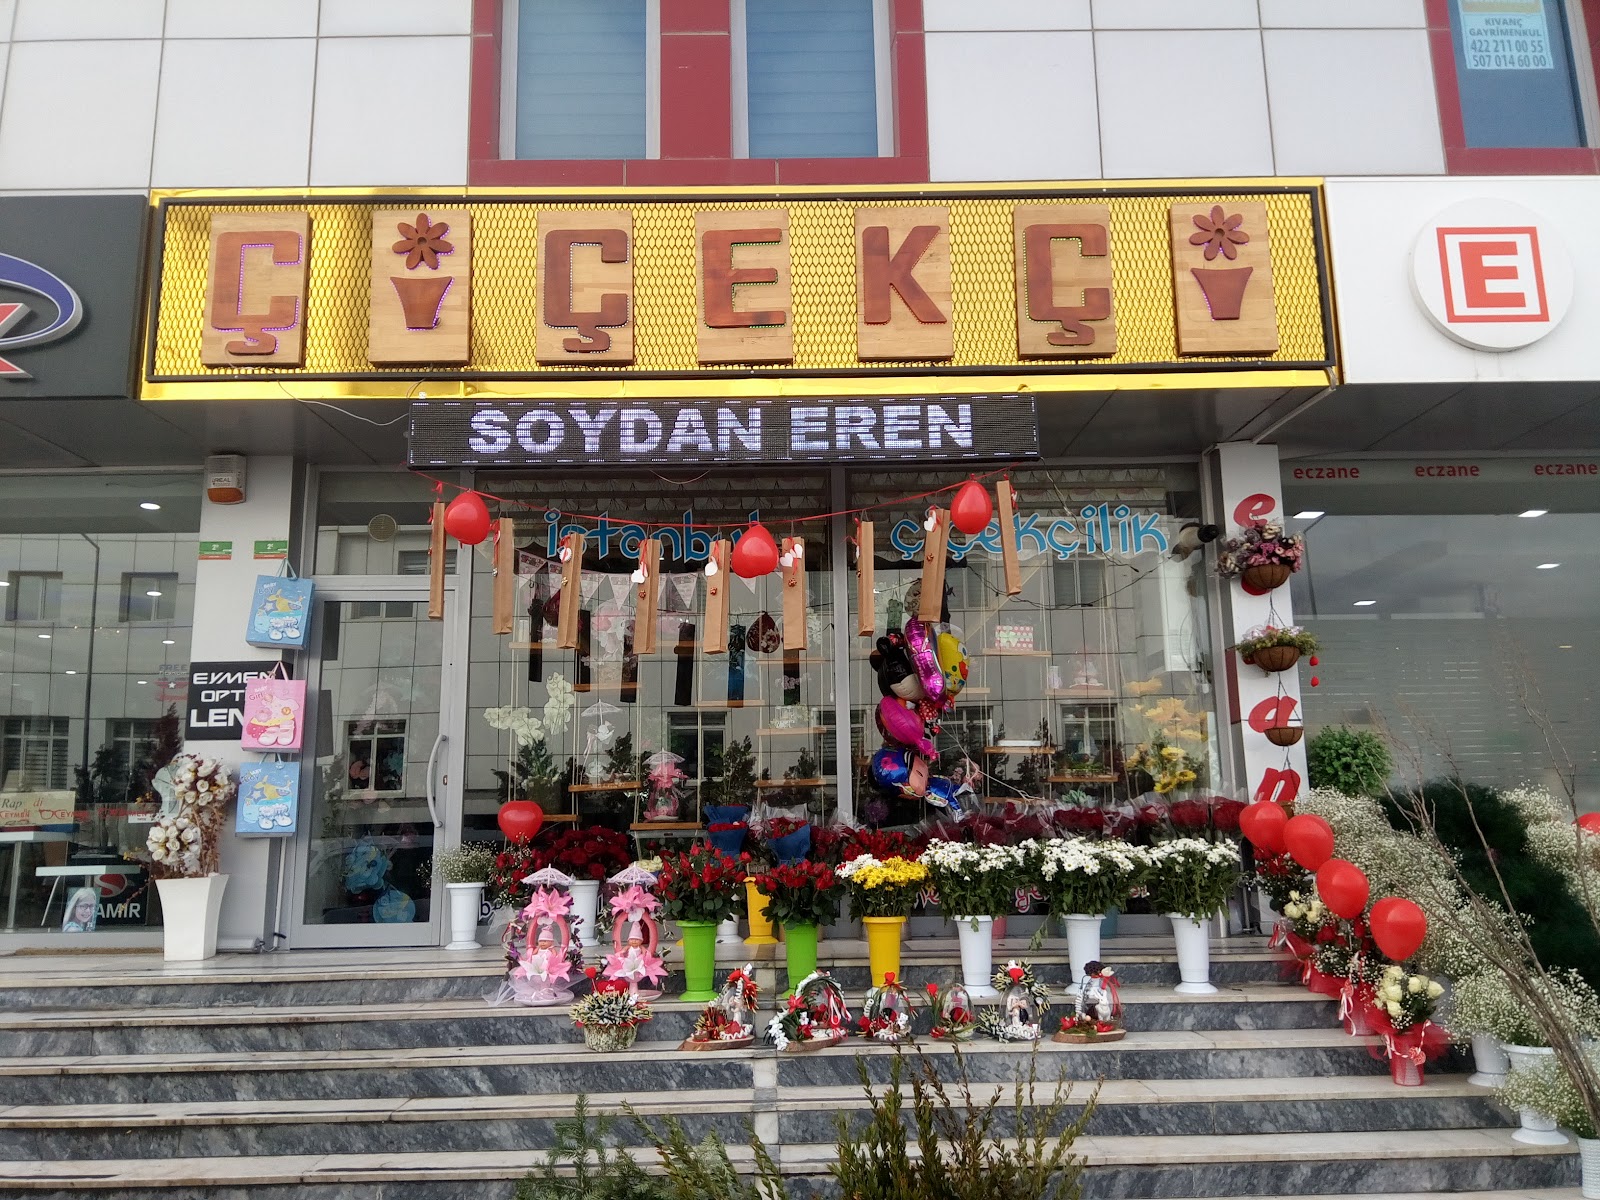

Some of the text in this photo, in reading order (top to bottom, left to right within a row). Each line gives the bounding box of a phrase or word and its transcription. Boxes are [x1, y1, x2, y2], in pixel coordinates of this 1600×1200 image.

[1484, 18, 1522, 28] KIVANÇ
[1469, 28, 1542, 37] GAYRİMENKUL
[1470, 40, 1544, 53] 422 211 00 55
[1473, 54, 1546, 67] 507 014 60 00
[1458, 241, 1527, 309] E
[468, 403, 973, 454] SOYDAN EREN
[1293, 465, 1360, 480] eczane
[1415, 463, 1480, 478] eczane
[1534, 462, 1598, 476] eczane
[890, 501, 1169, 561] ççekçilik
[201, 689, 248, 703] OPT
[190, 708, 244, 728] LEN
